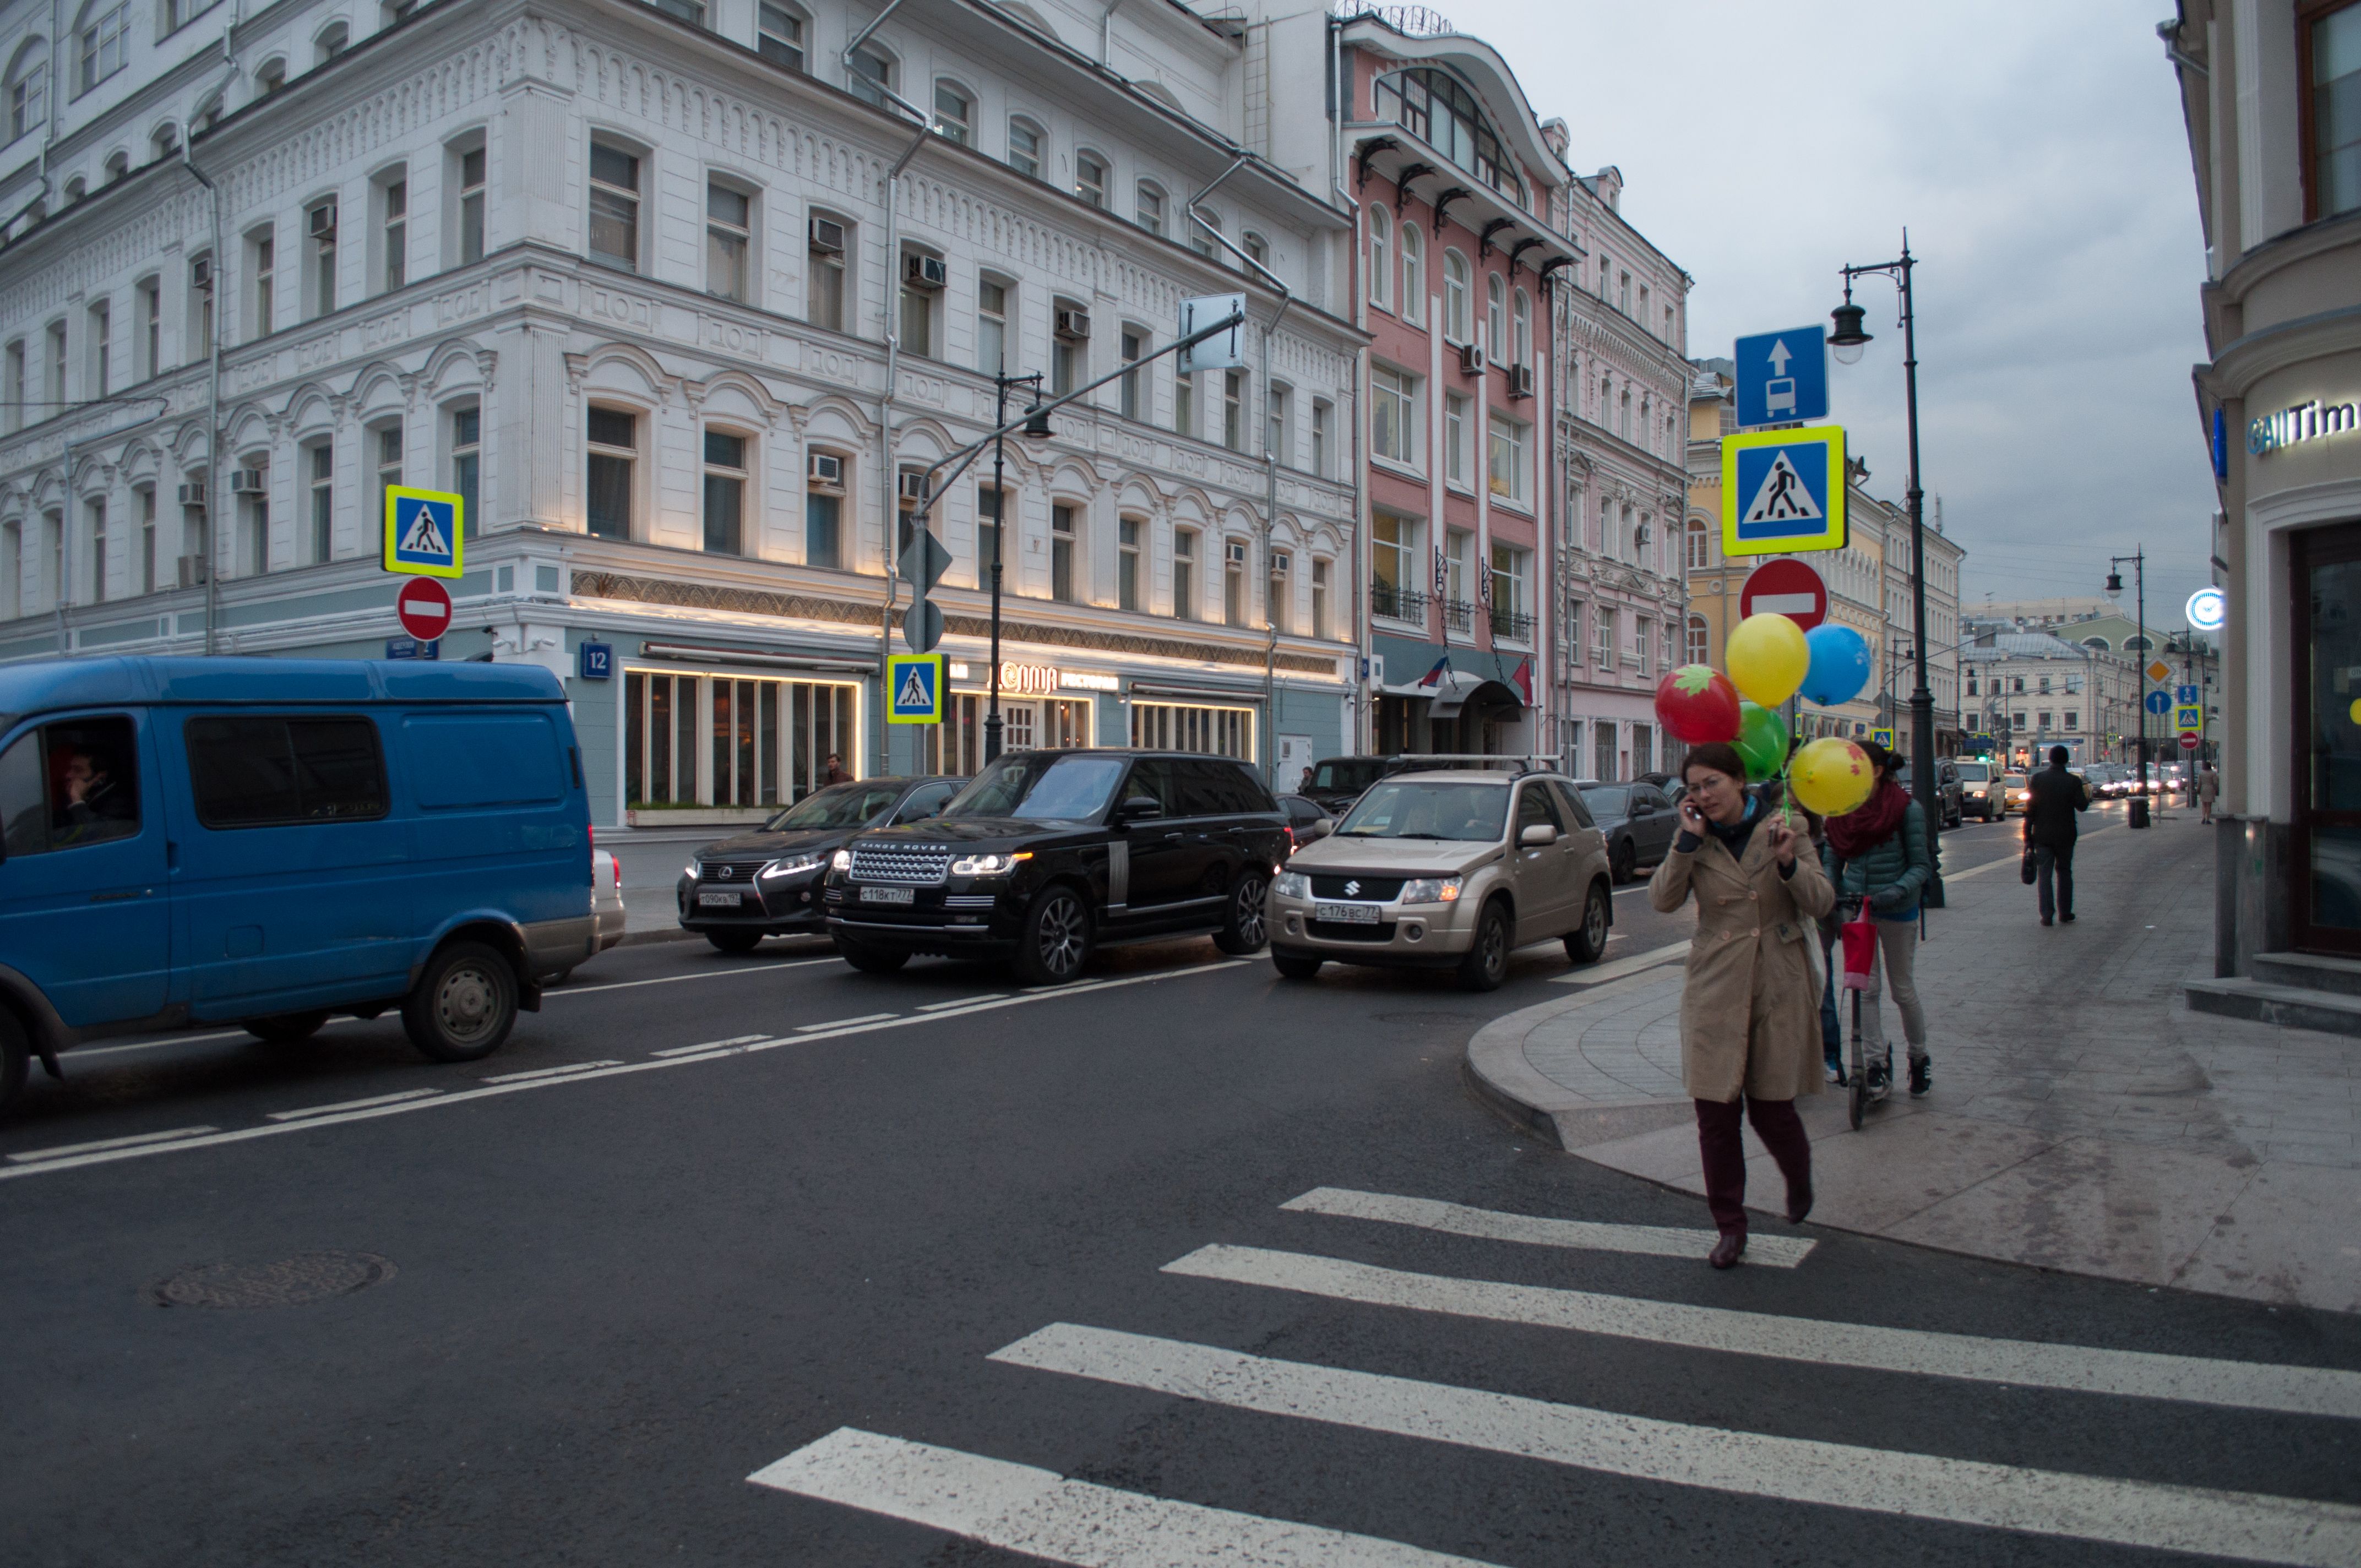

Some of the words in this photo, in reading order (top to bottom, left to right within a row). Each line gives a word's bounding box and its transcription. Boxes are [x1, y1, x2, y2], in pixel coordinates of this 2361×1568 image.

[2261, 400, 2361, 453] AllTim
[590, 652, 606, 669] 12
[1060, 672, 1119, 690] РЕСТОРАН
[1366, 906, 1375, 916] 77
